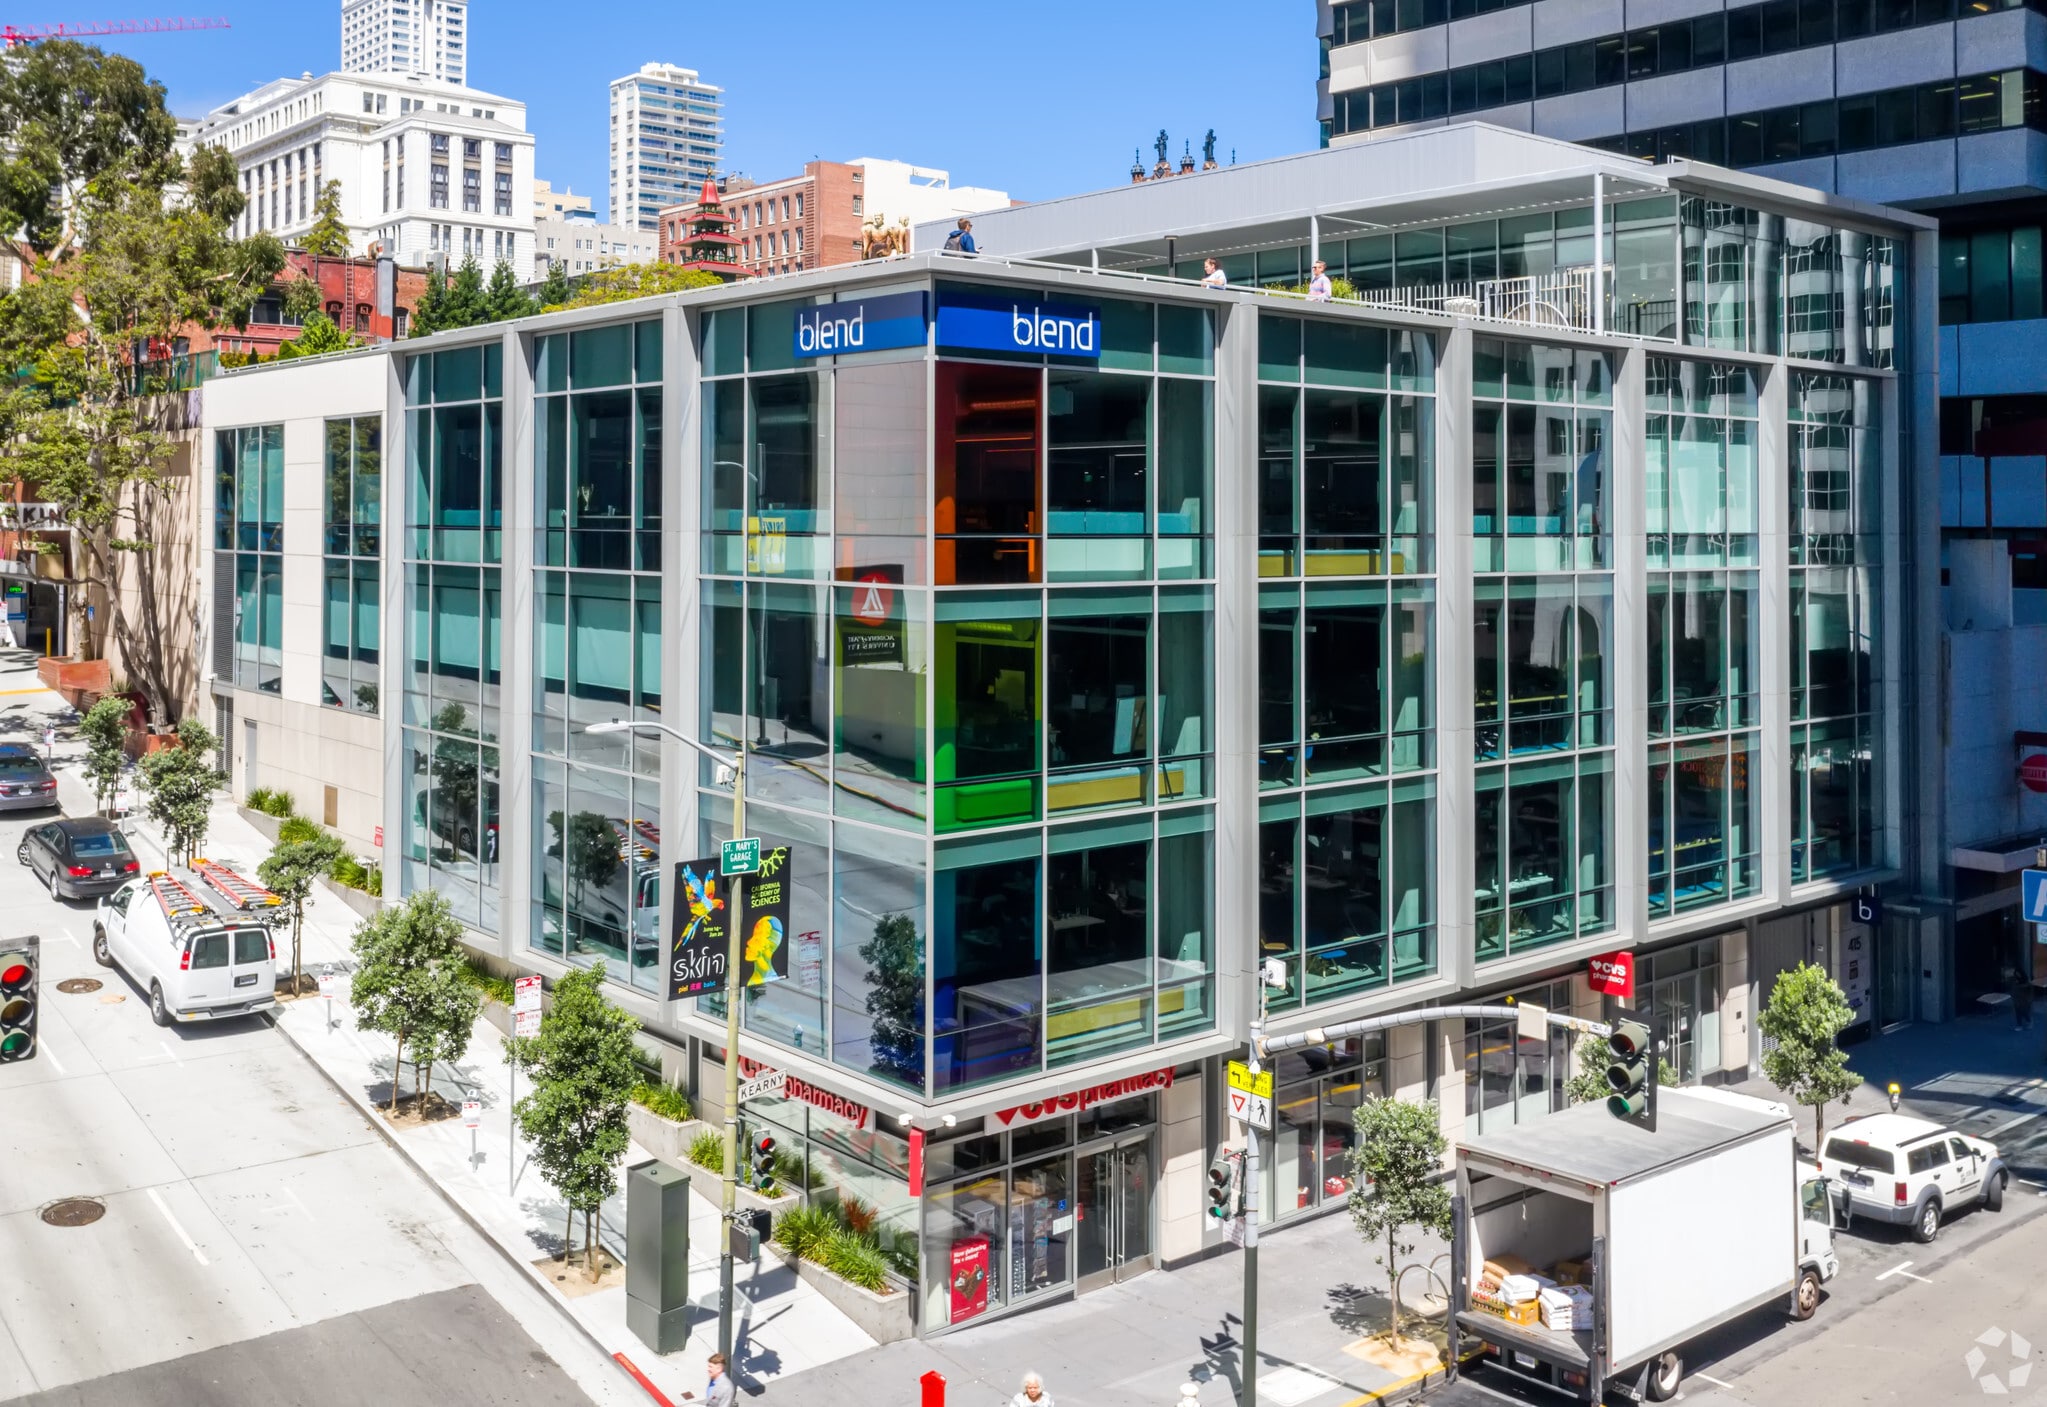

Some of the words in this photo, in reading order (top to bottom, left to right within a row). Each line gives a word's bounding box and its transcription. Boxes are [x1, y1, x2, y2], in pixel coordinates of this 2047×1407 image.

[800, 305, 863, 351] blend
[1013, 304, 1093, 351] blend
[724, 843, 733, 853] ST.
[735, 840, 758, 851] MARY'S
[729, 851, 752, 862] GARAGE
[751, 881, 781, 893] CALIFORNIA
[751, 894, 781, 908] SCIENCES
[1859, 899, 1872, 920] b
[673, 946, 725, 982] skin
[1602, 962, 1627, 977] CVS
[1592, 972, 1626, 986] pharmacy
[740, 1073, 785, 1100] KEARNY
[783, 1075, 869, 1129] pharmacy
